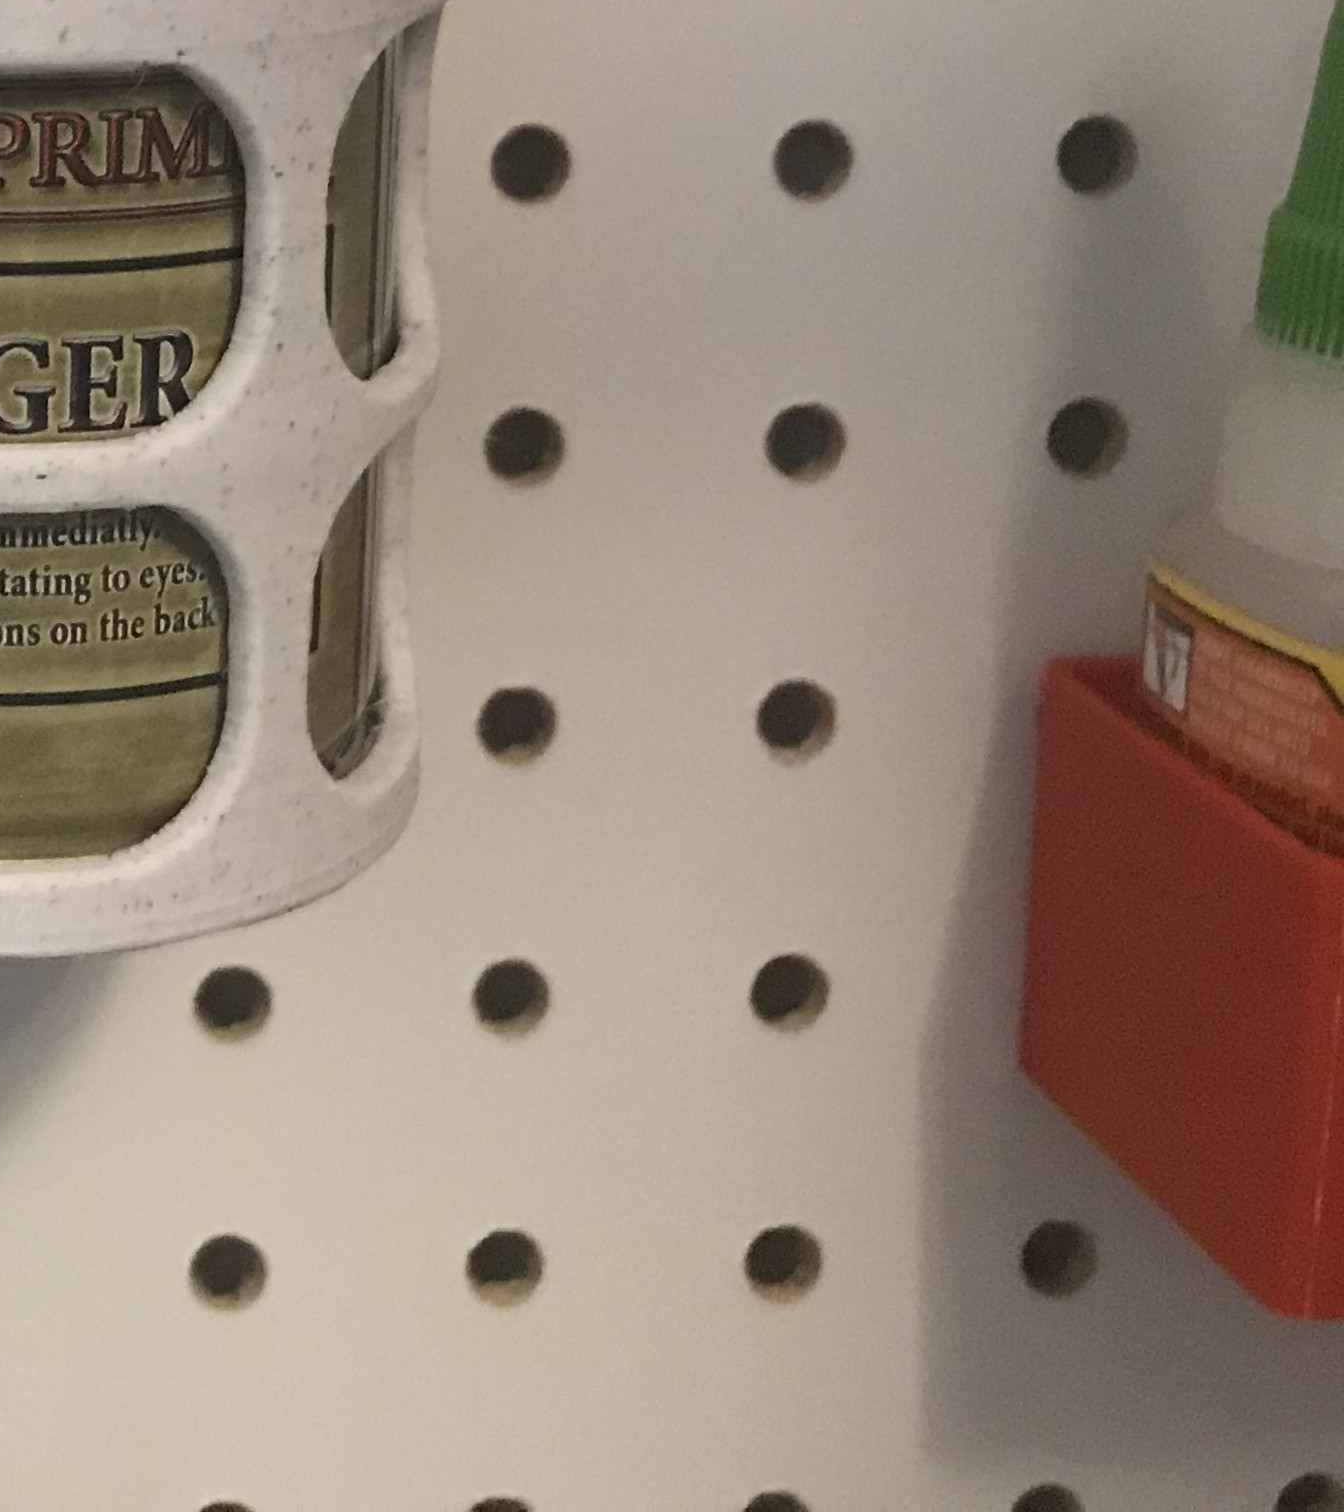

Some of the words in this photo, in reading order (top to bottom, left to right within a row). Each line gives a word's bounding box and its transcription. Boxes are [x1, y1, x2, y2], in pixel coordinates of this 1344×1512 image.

[100, 563, 132, 593] to
[138, 559, 208, 599] eyes.
[49, 621, 89, 646] on
[99, 608, 146, 642] the
[153, 596, 217, 636] back
